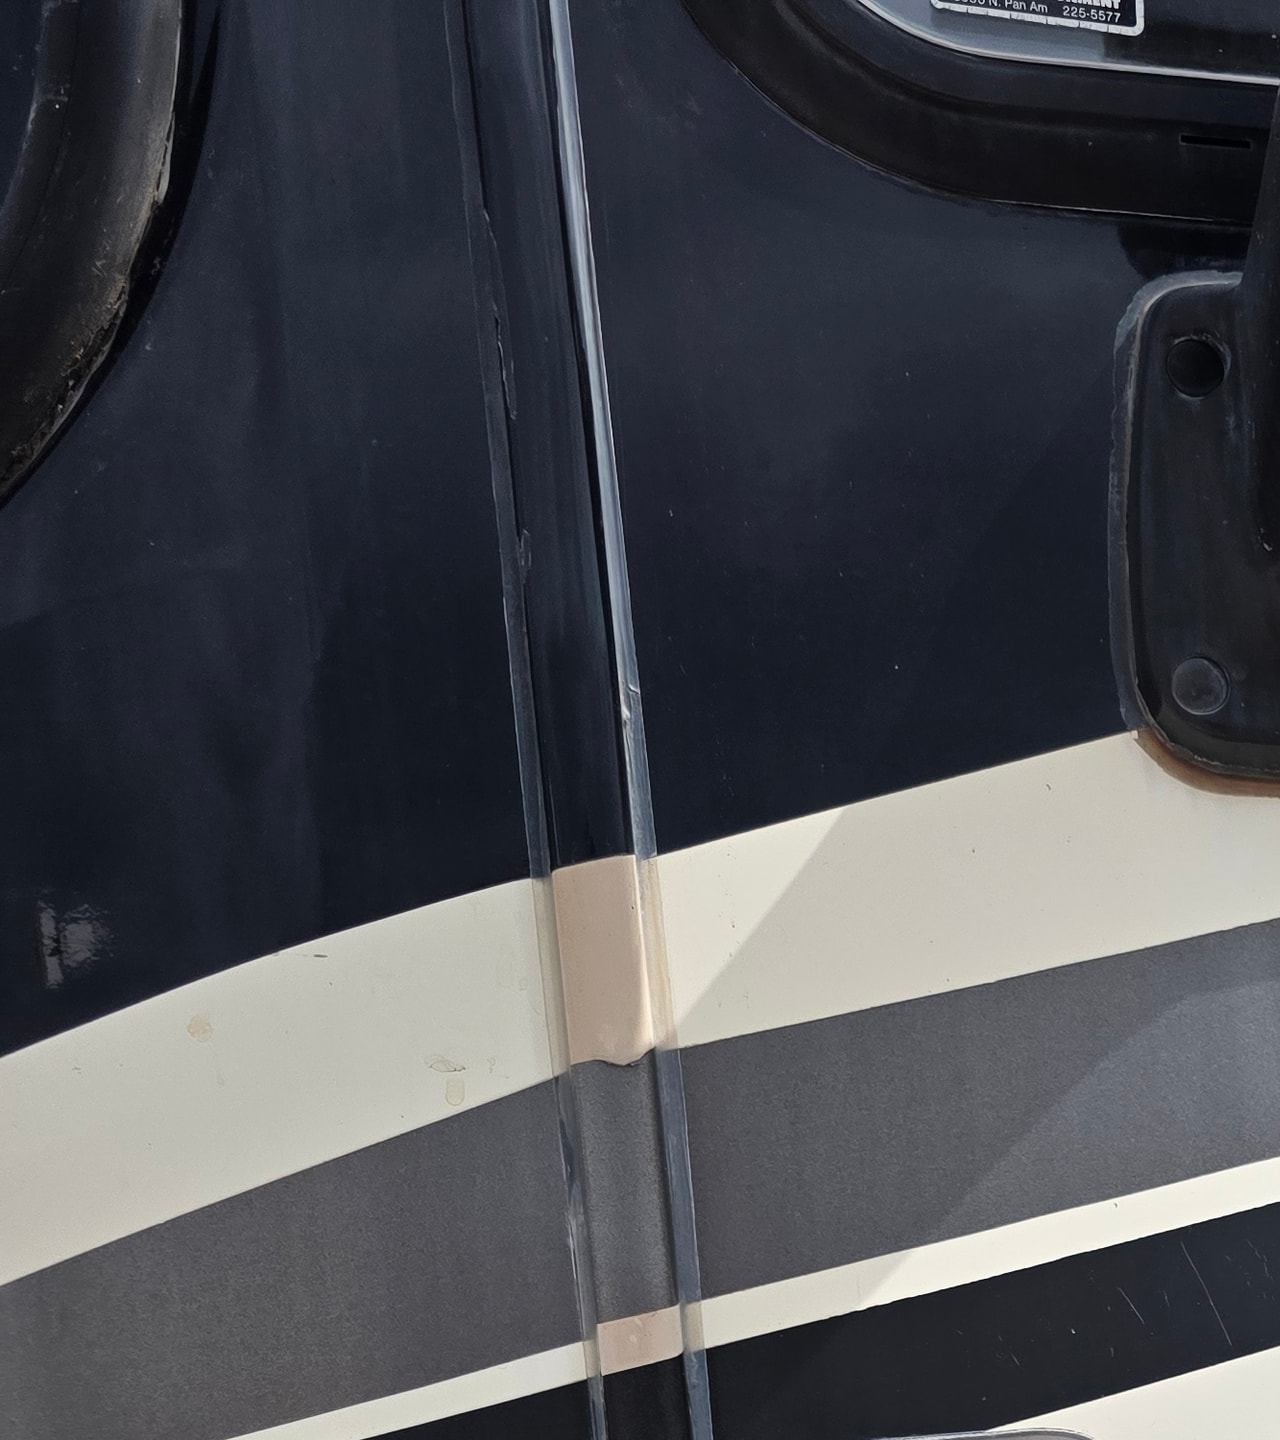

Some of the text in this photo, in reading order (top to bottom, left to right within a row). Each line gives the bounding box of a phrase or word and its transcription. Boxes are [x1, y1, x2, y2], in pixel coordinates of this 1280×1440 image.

[1004, 0, 1027, 10] Pan
[1029, 1, 1048, 13] Am
[1062, 5, 1121, 23] 225-5577
